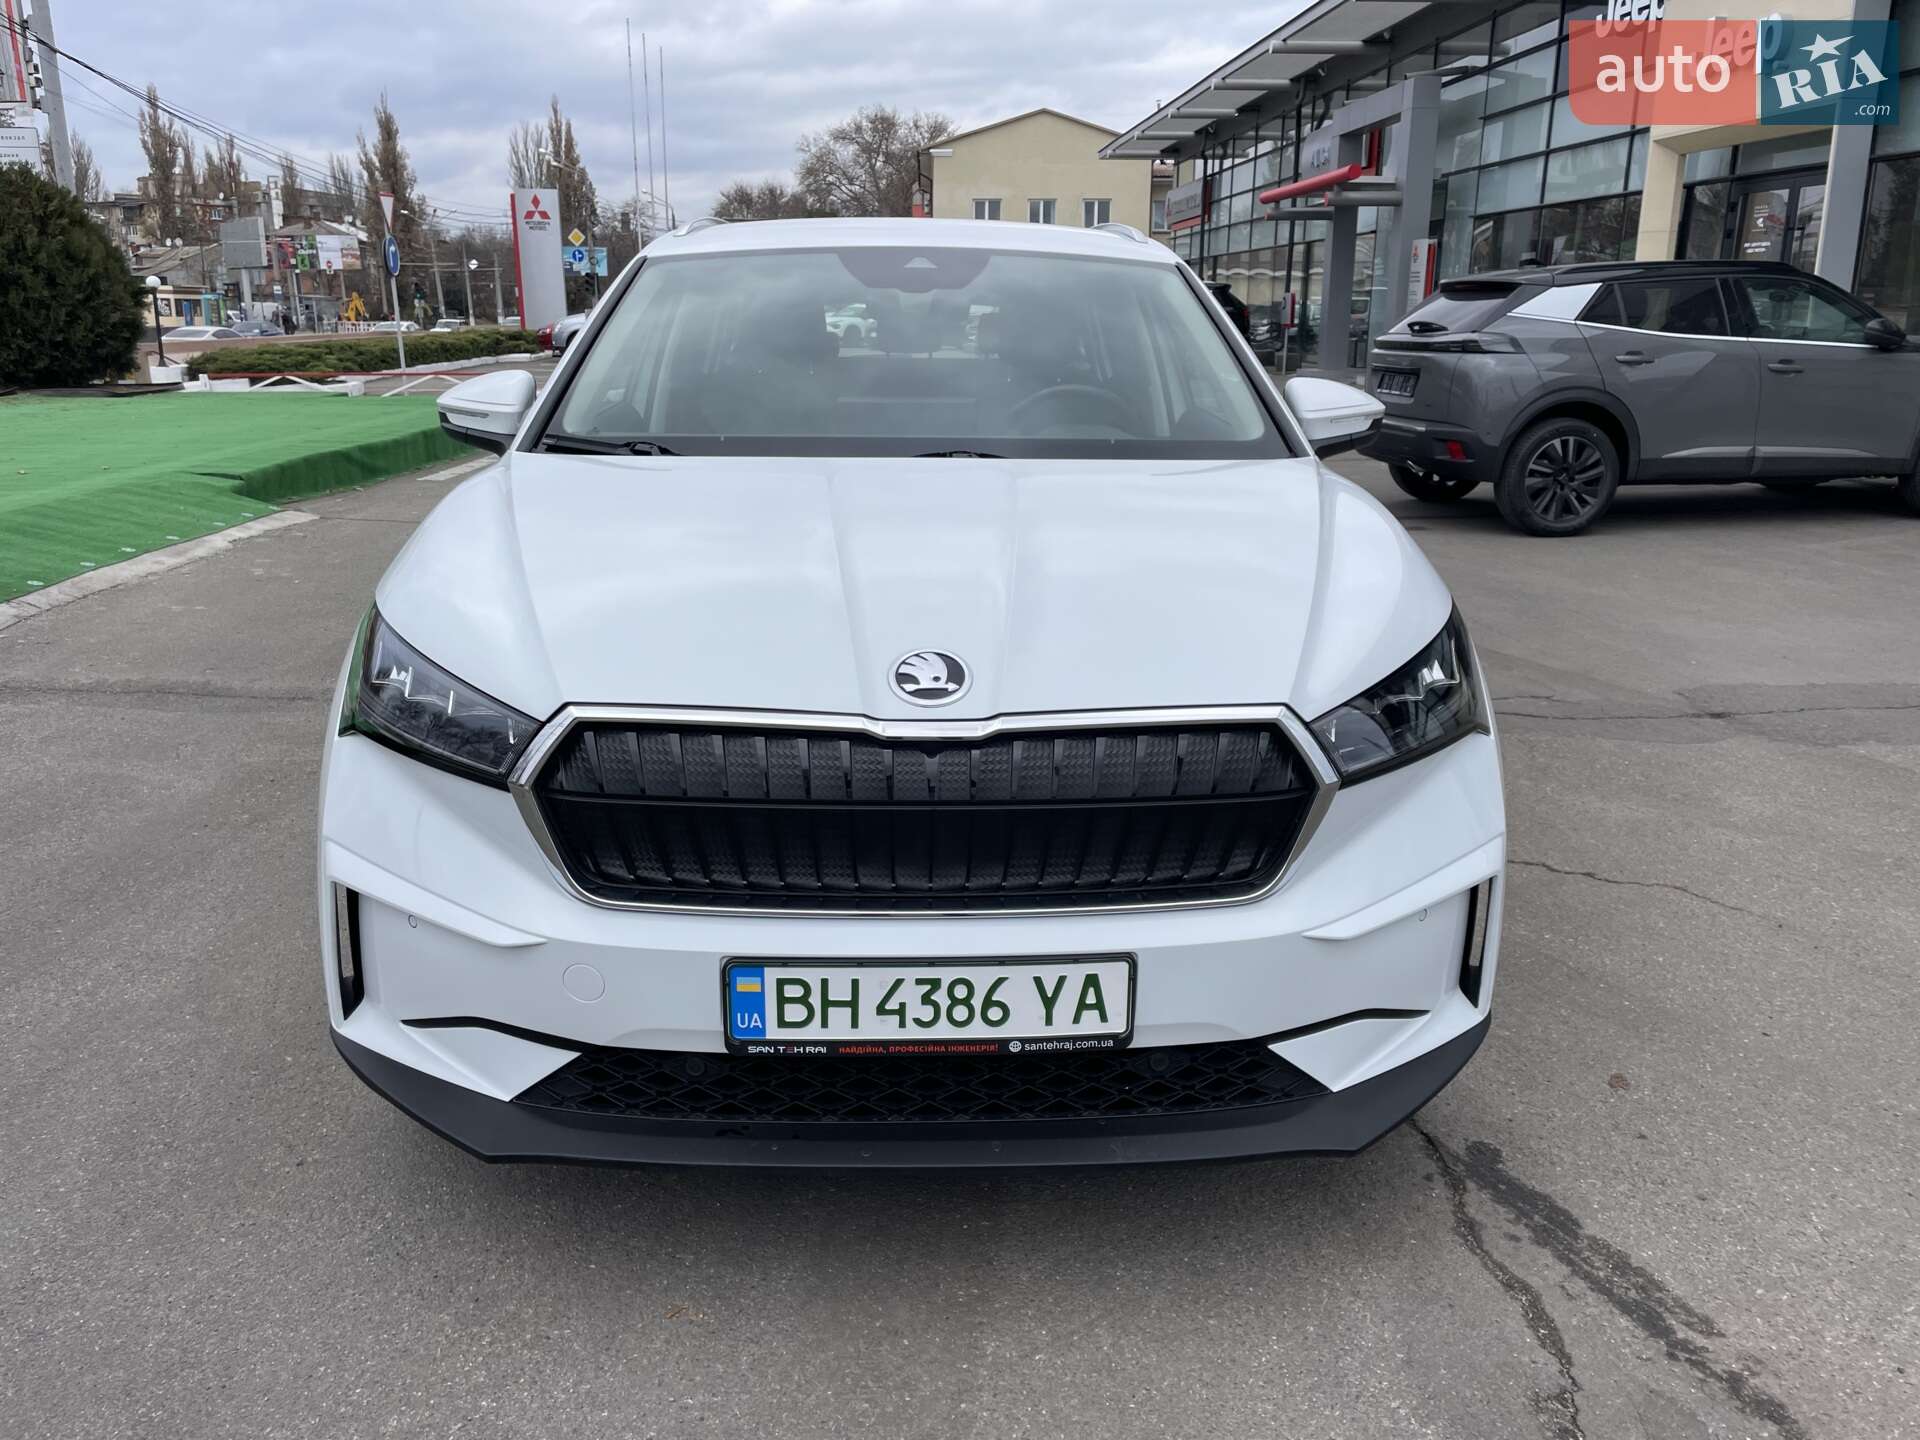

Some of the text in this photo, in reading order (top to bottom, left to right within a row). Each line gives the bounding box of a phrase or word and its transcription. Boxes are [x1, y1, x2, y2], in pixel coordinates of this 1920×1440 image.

[775, 973, 1109, 1029] BH 4386 YA
[737, 1013, 763, 1029] UA
[747, 1046, 774, 1054] SAN
[1024, 1039, 1114, 1051] santehraj.com.ua
